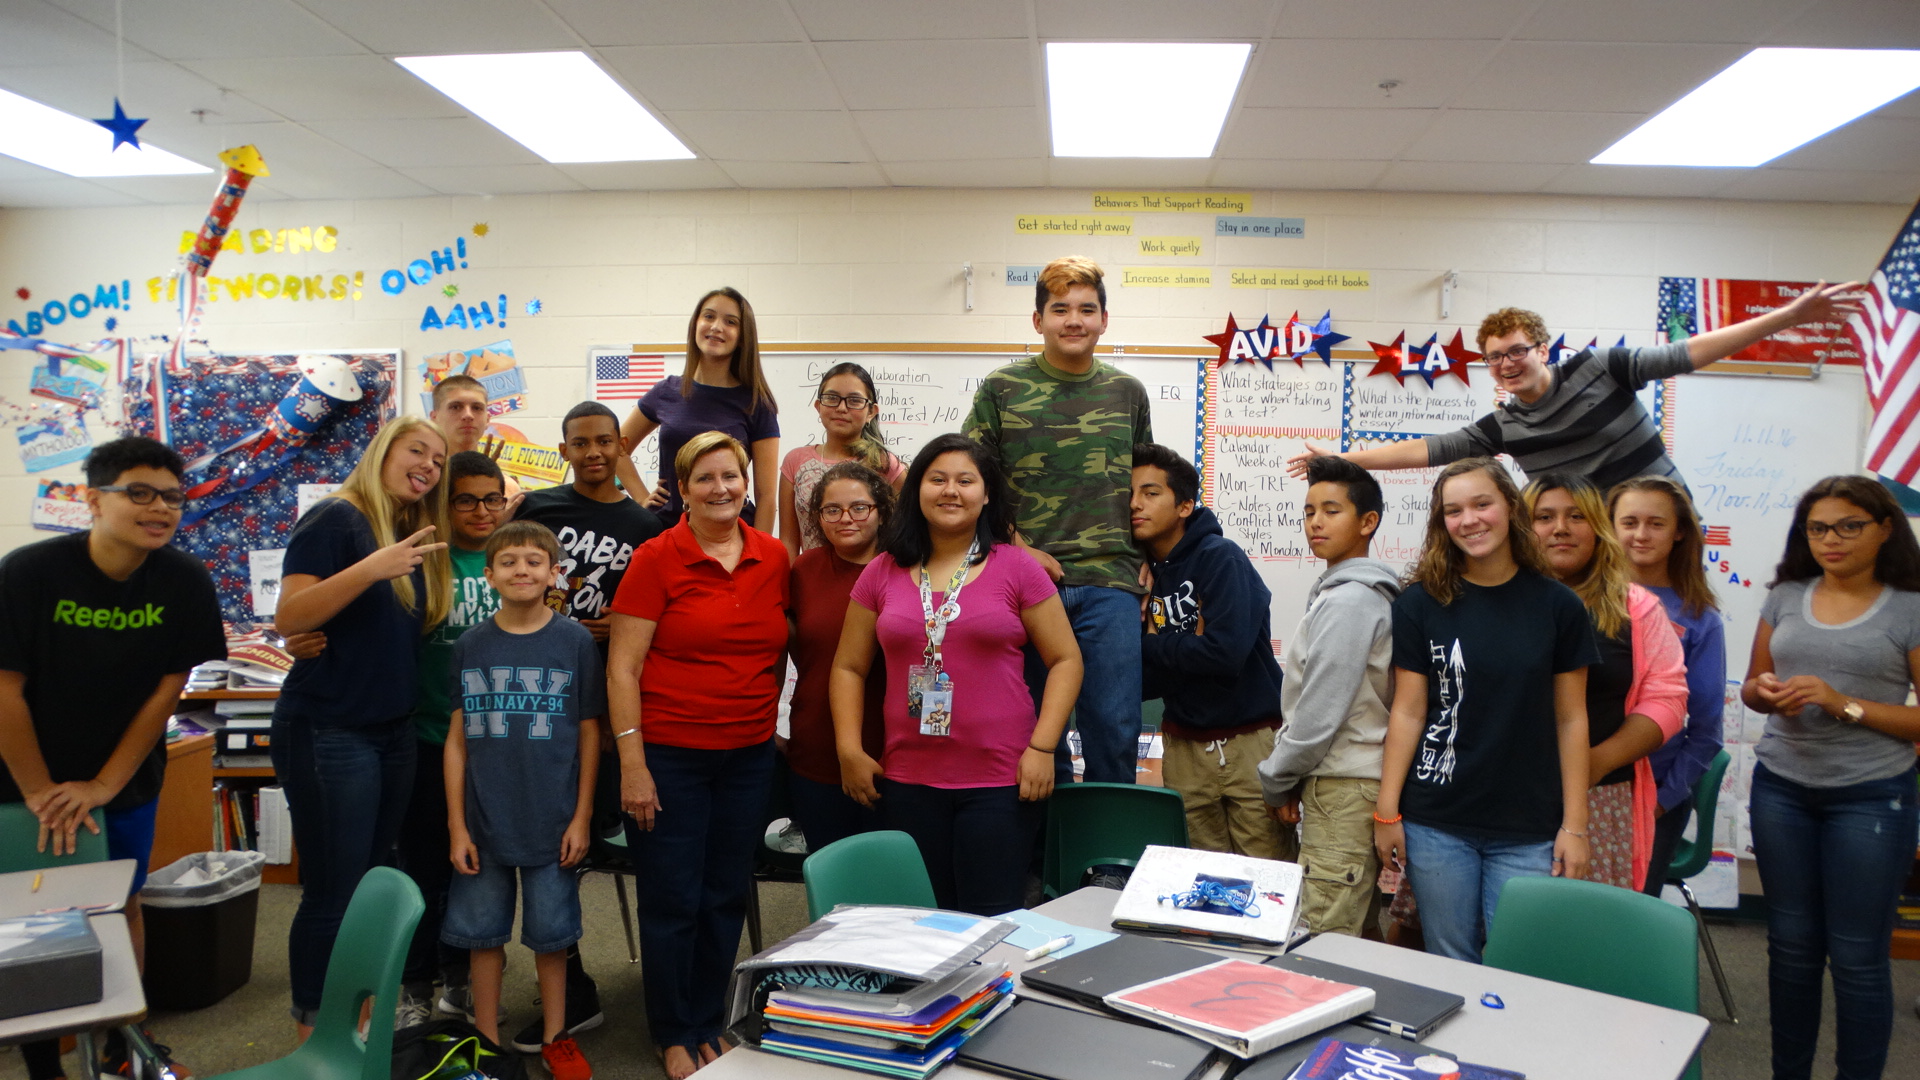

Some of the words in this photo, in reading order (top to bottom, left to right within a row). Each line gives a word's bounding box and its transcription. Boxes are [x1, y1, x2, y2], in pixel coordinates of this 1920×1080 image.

[1094, 196, 1138, 208] Behaviors
[1142, 196, 1161, 208] That
[1165, 197, 1201, 211] Support
[1205, 197, 1244, 213] Reading
[1018, 218, 1038, 230] Get
[1043, 219, 1078, 231] started
[1081, 220, 1102, 236] right
[1104, 223, 1131, 235] away
[1217, 220, 1238, 235] Stay
[1241, 222, 1249, 233] in
[1253, 225, 1270, 234] one
[178, 226, 339, 254] RADING
[1141, 240, 1166, 253] Work
[1170, 240, 1200, 256] quietly
[380, 236, 468, 296] OOH!
[1006, 270, 1028, 282] Read
[1123, 271, 1170, 284] Increase
[1174, 271, 1210, 284] stamina
[1231, 272, 1257, 285] Select
[1260, 273, 1277, 286] and
[1280, 273, 1299, 286] read
[1342, 275, 1369, 287] books
[146, 271, 364, 303] FIEWORKS!
[1777, 286, 1800, 297] The
[420, 294, 507, 331] AAH!
[1228, 325, 1313, 359] AVID
[1401, 342, 1450, 371] LA
[1160, 385, 1181, 401] EQ
[1220, 371, 1251, 389] What
[1254, 374, 1310, 397] strategies
[1315, 381, 1338, 393] can
[1220, 390, 1233, 403] I
[1236, 394, 1254, 404] use
[1261, 391, 1289, 404] when
[1293, 391, 1331, 412] taking
[1357, 386, 1387, 404] What
[1393, 393, 1403, 404] is
[1405, 391, 1422, 406] the
[1425, 394, 1461, 411] process
[1465, 393, 1477, 408] to
[898, 405, 927, 421] Test
[1224, 408, 1234, 418] a
[1241, 405, 1277, 419] test?
[1359, 406, 1383, 420] write
[1386, 409, 1399, 419] an
[1401, 408, 1475, 422] informational
[1359, 419, 1403, 431] essay?
[23, 431, 88, 458] MYTHOLOGY
[1220, 436, 1276, 454] Calendar:
[516, 447, 565, 471] FICTION
[1235, 453, 1267, 468] Week
[1269, 455, 1283, 468] of
[1382, 474, 1418, 485] boxes
[1276, 500, 1294, 512] on
[1698, 484, 1750, 512] Nov.
[1227, 512, 1273, 527] Conflict
[1238, 527, 1272, 545] Styles
[1260, 541, 1303, 566] Monday
[1708, 551, 1740, 584] USA
[53, 599, 165, 630] Reebok
[461, 667, 573, 740] NY
